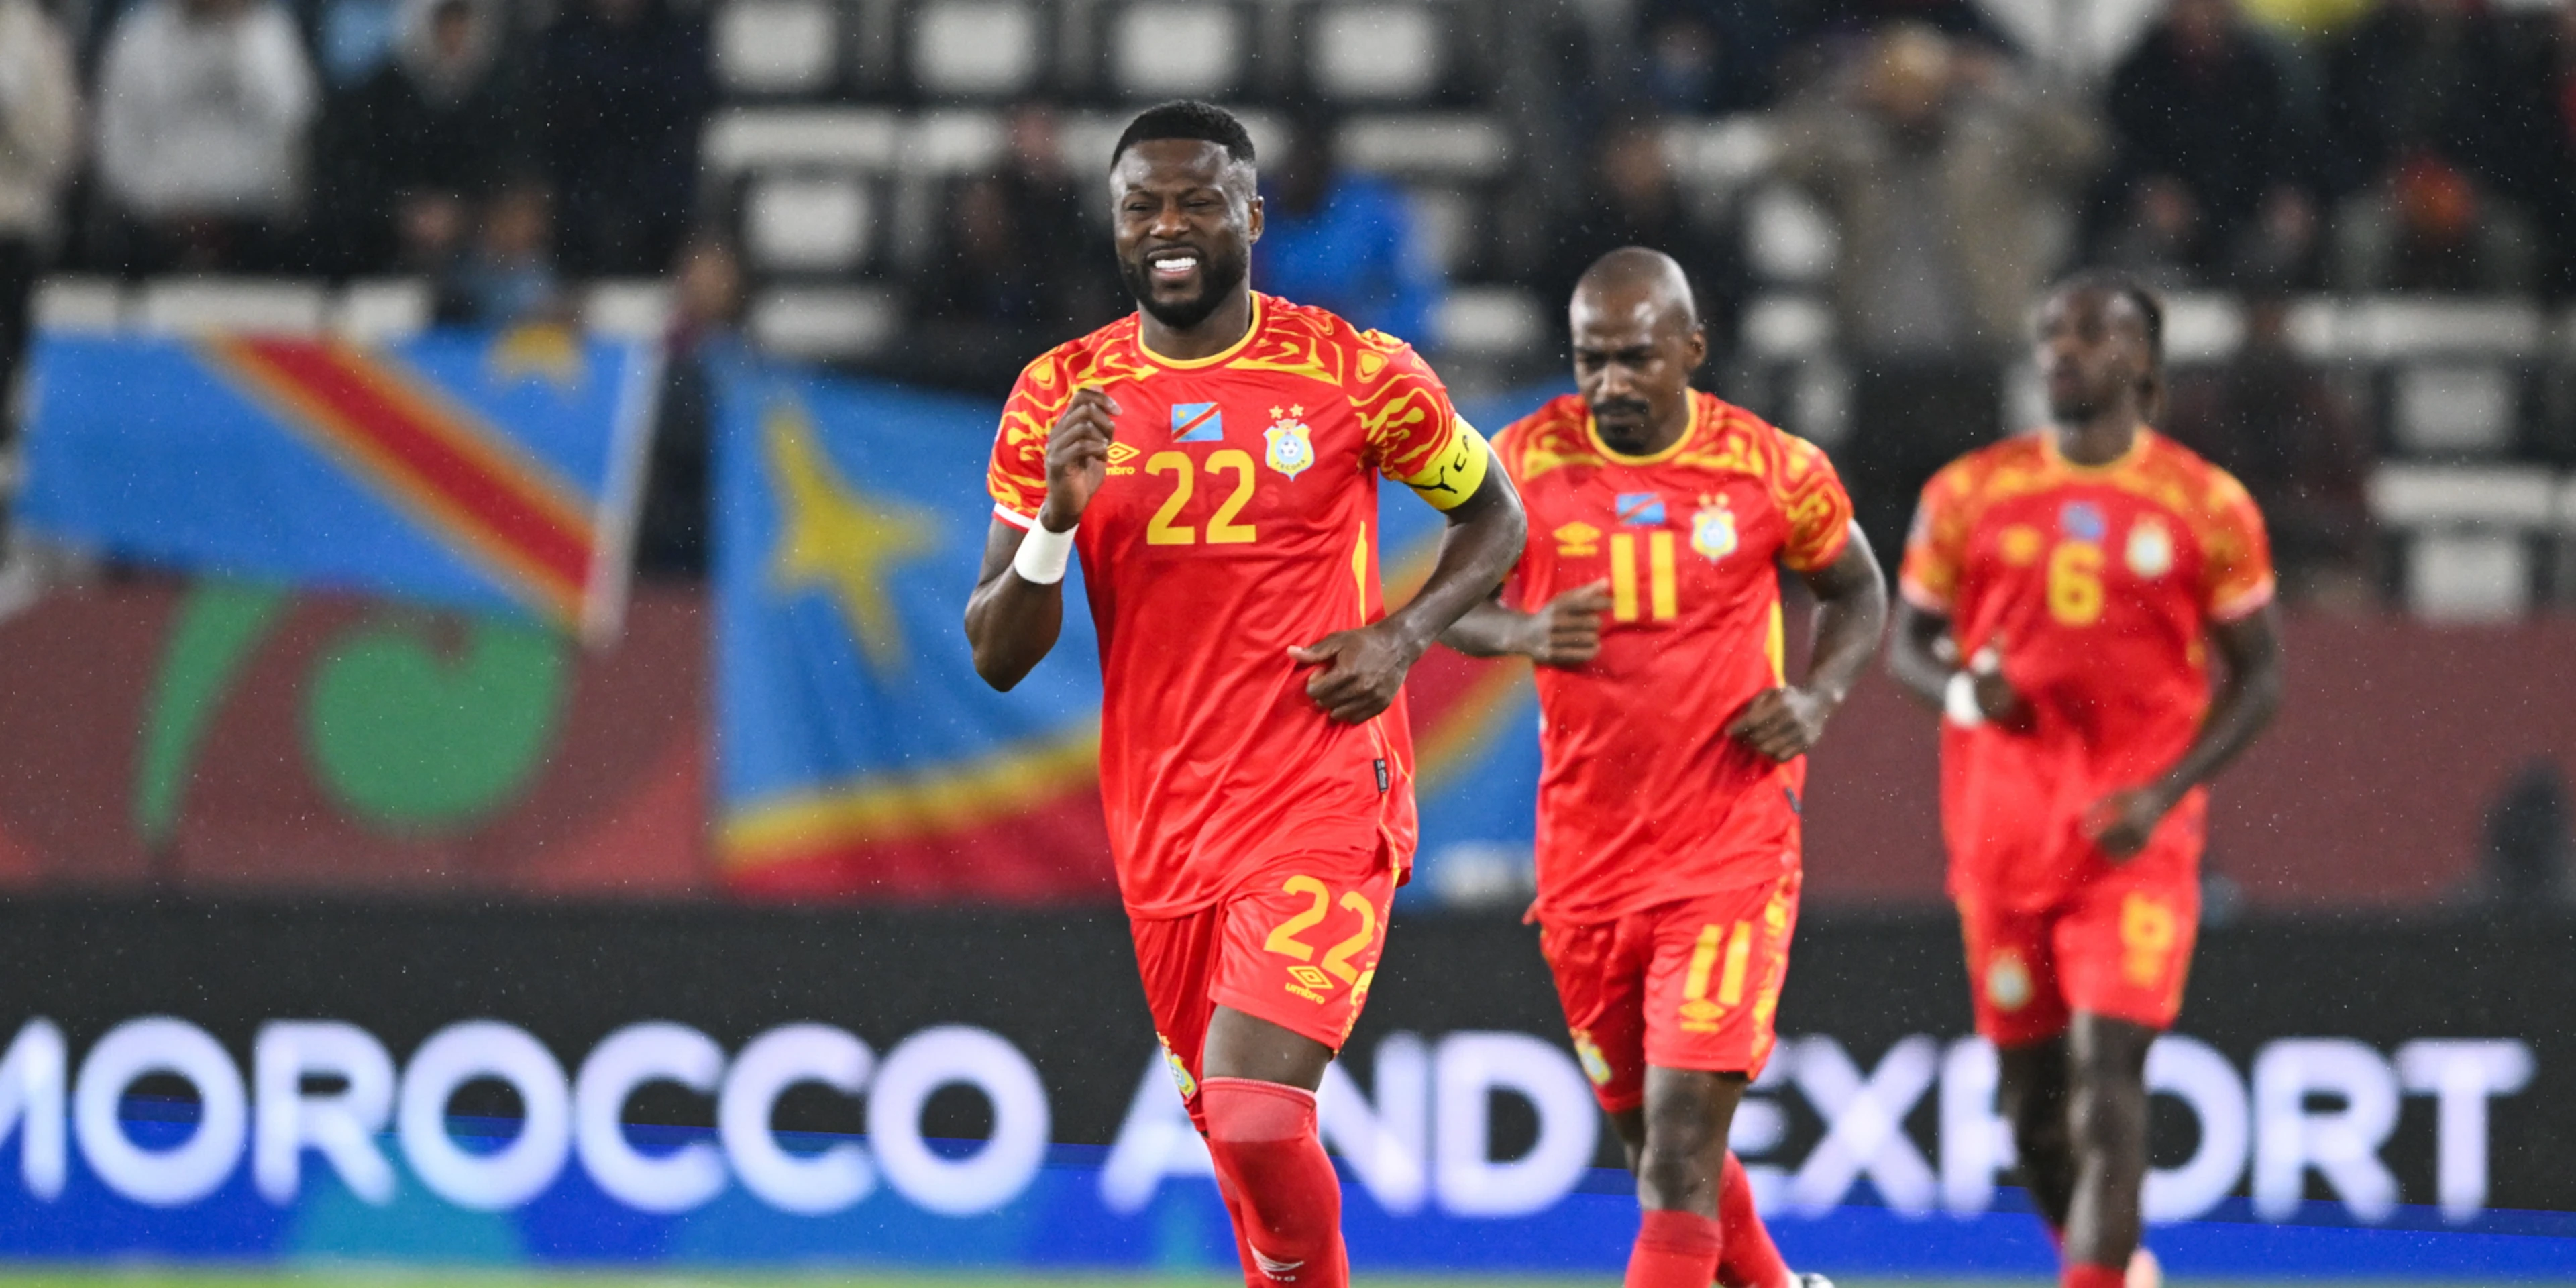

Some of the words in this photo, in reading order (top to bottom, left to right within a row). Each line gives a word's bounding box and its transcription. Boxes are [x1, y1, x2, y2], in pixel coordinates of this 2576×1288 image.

[1106, 465, 1136, 476] mbro
[1144, 449, 1256, 545] 22
[1611, 531, 1676, 621] 11
[2049, 540, 2104, 627] 6
[1263, 875, 1375, 985] 22
[1683, 920, 1751, 1005] 11
[1285, 982, 1326, 1004] umbro
